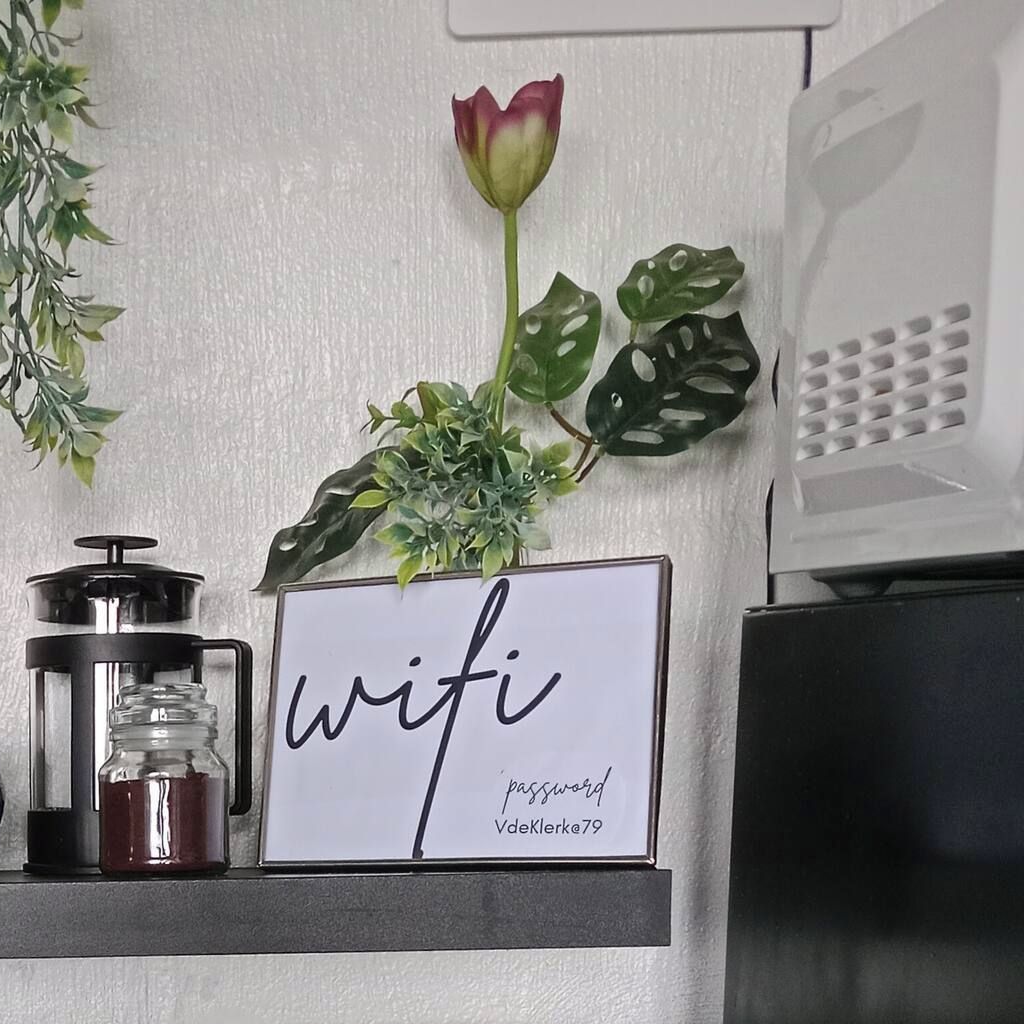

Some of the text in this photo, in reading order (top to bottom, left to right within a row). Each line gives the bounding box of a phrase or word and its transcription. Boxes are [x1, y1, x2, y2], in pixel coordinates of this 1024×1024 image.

[286, 577, 562, 859] wifi
[502, 766, 612, 815] password
[494, 818, 603, 834] VdeKlerk@79
